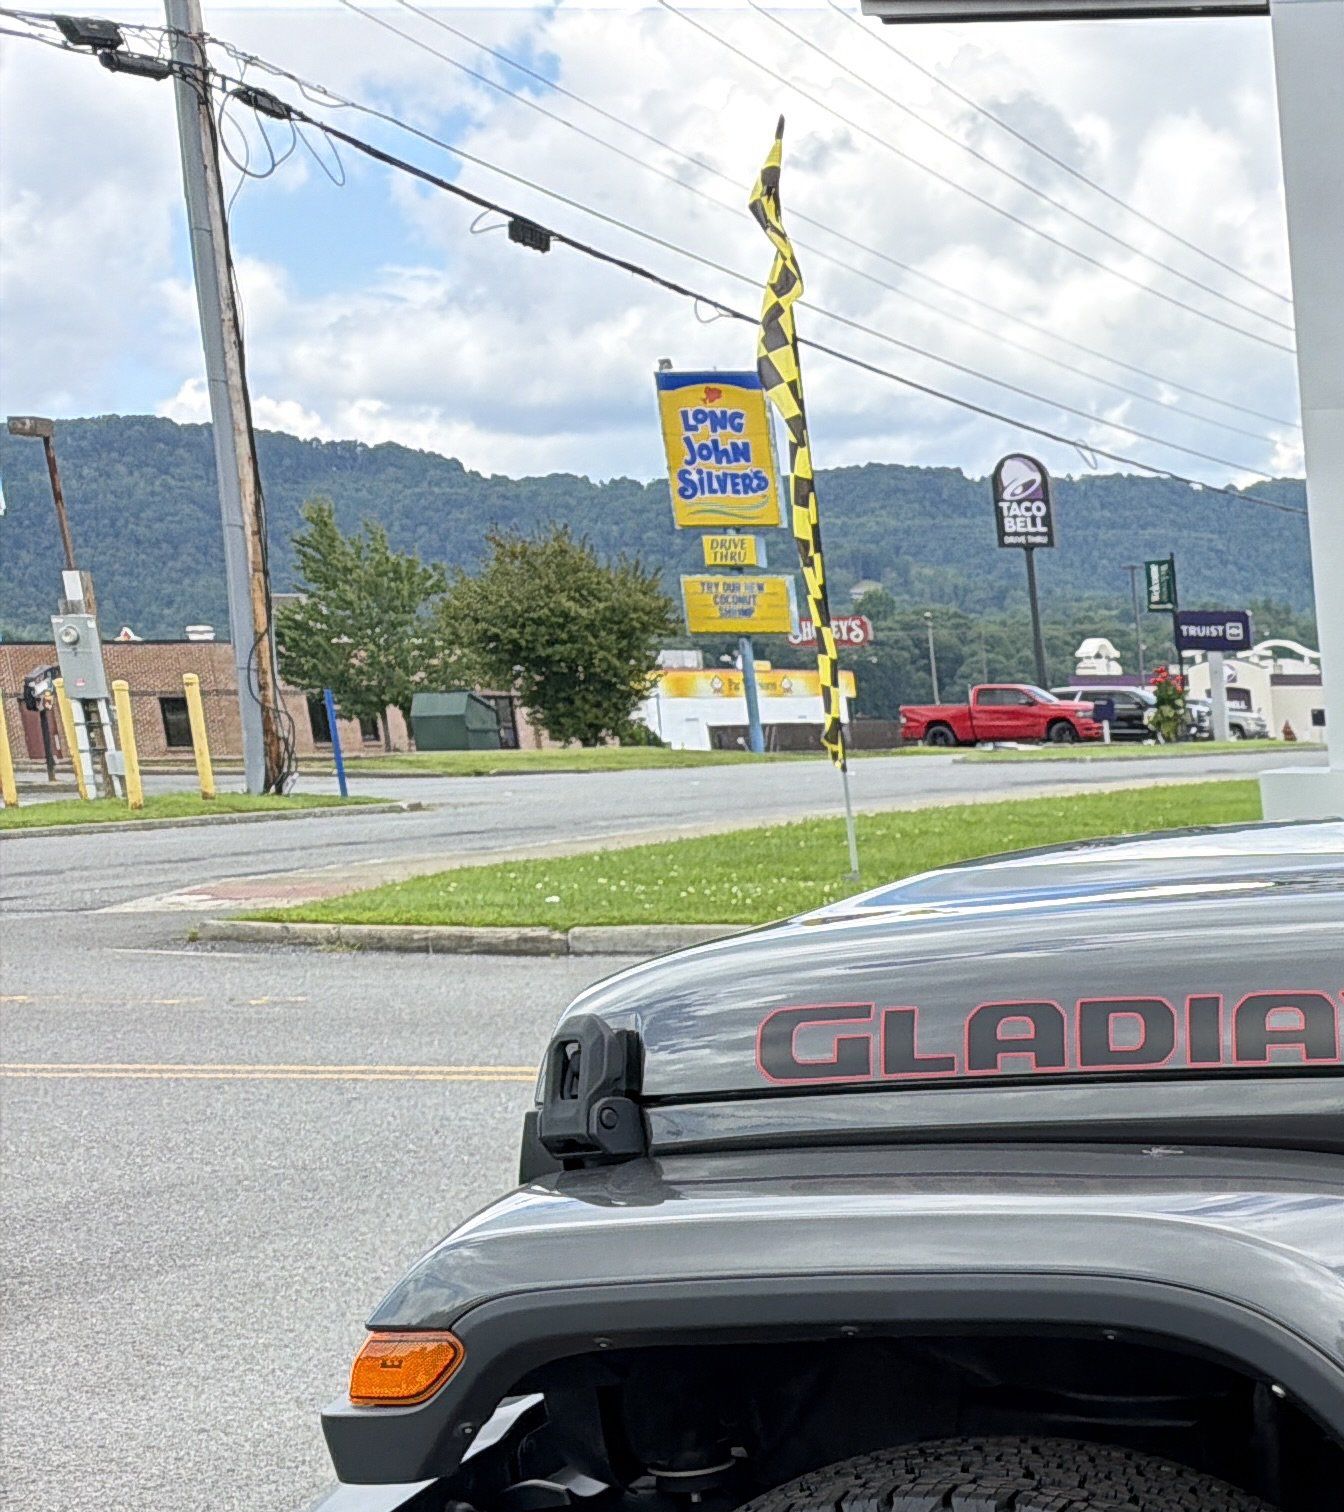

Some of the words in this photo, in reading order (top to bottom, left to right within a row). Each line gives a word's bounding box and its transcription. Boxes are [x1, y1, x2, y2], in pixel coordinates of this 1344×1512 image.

[998, 500, 1047, 517] TACO
[1003, 516, 1049, 533] BELL
[710, 538, 747, 550] DRIVE
[712, 550, 747, 563] THRU
[1180, 624, 1224, 638] TRUIST
